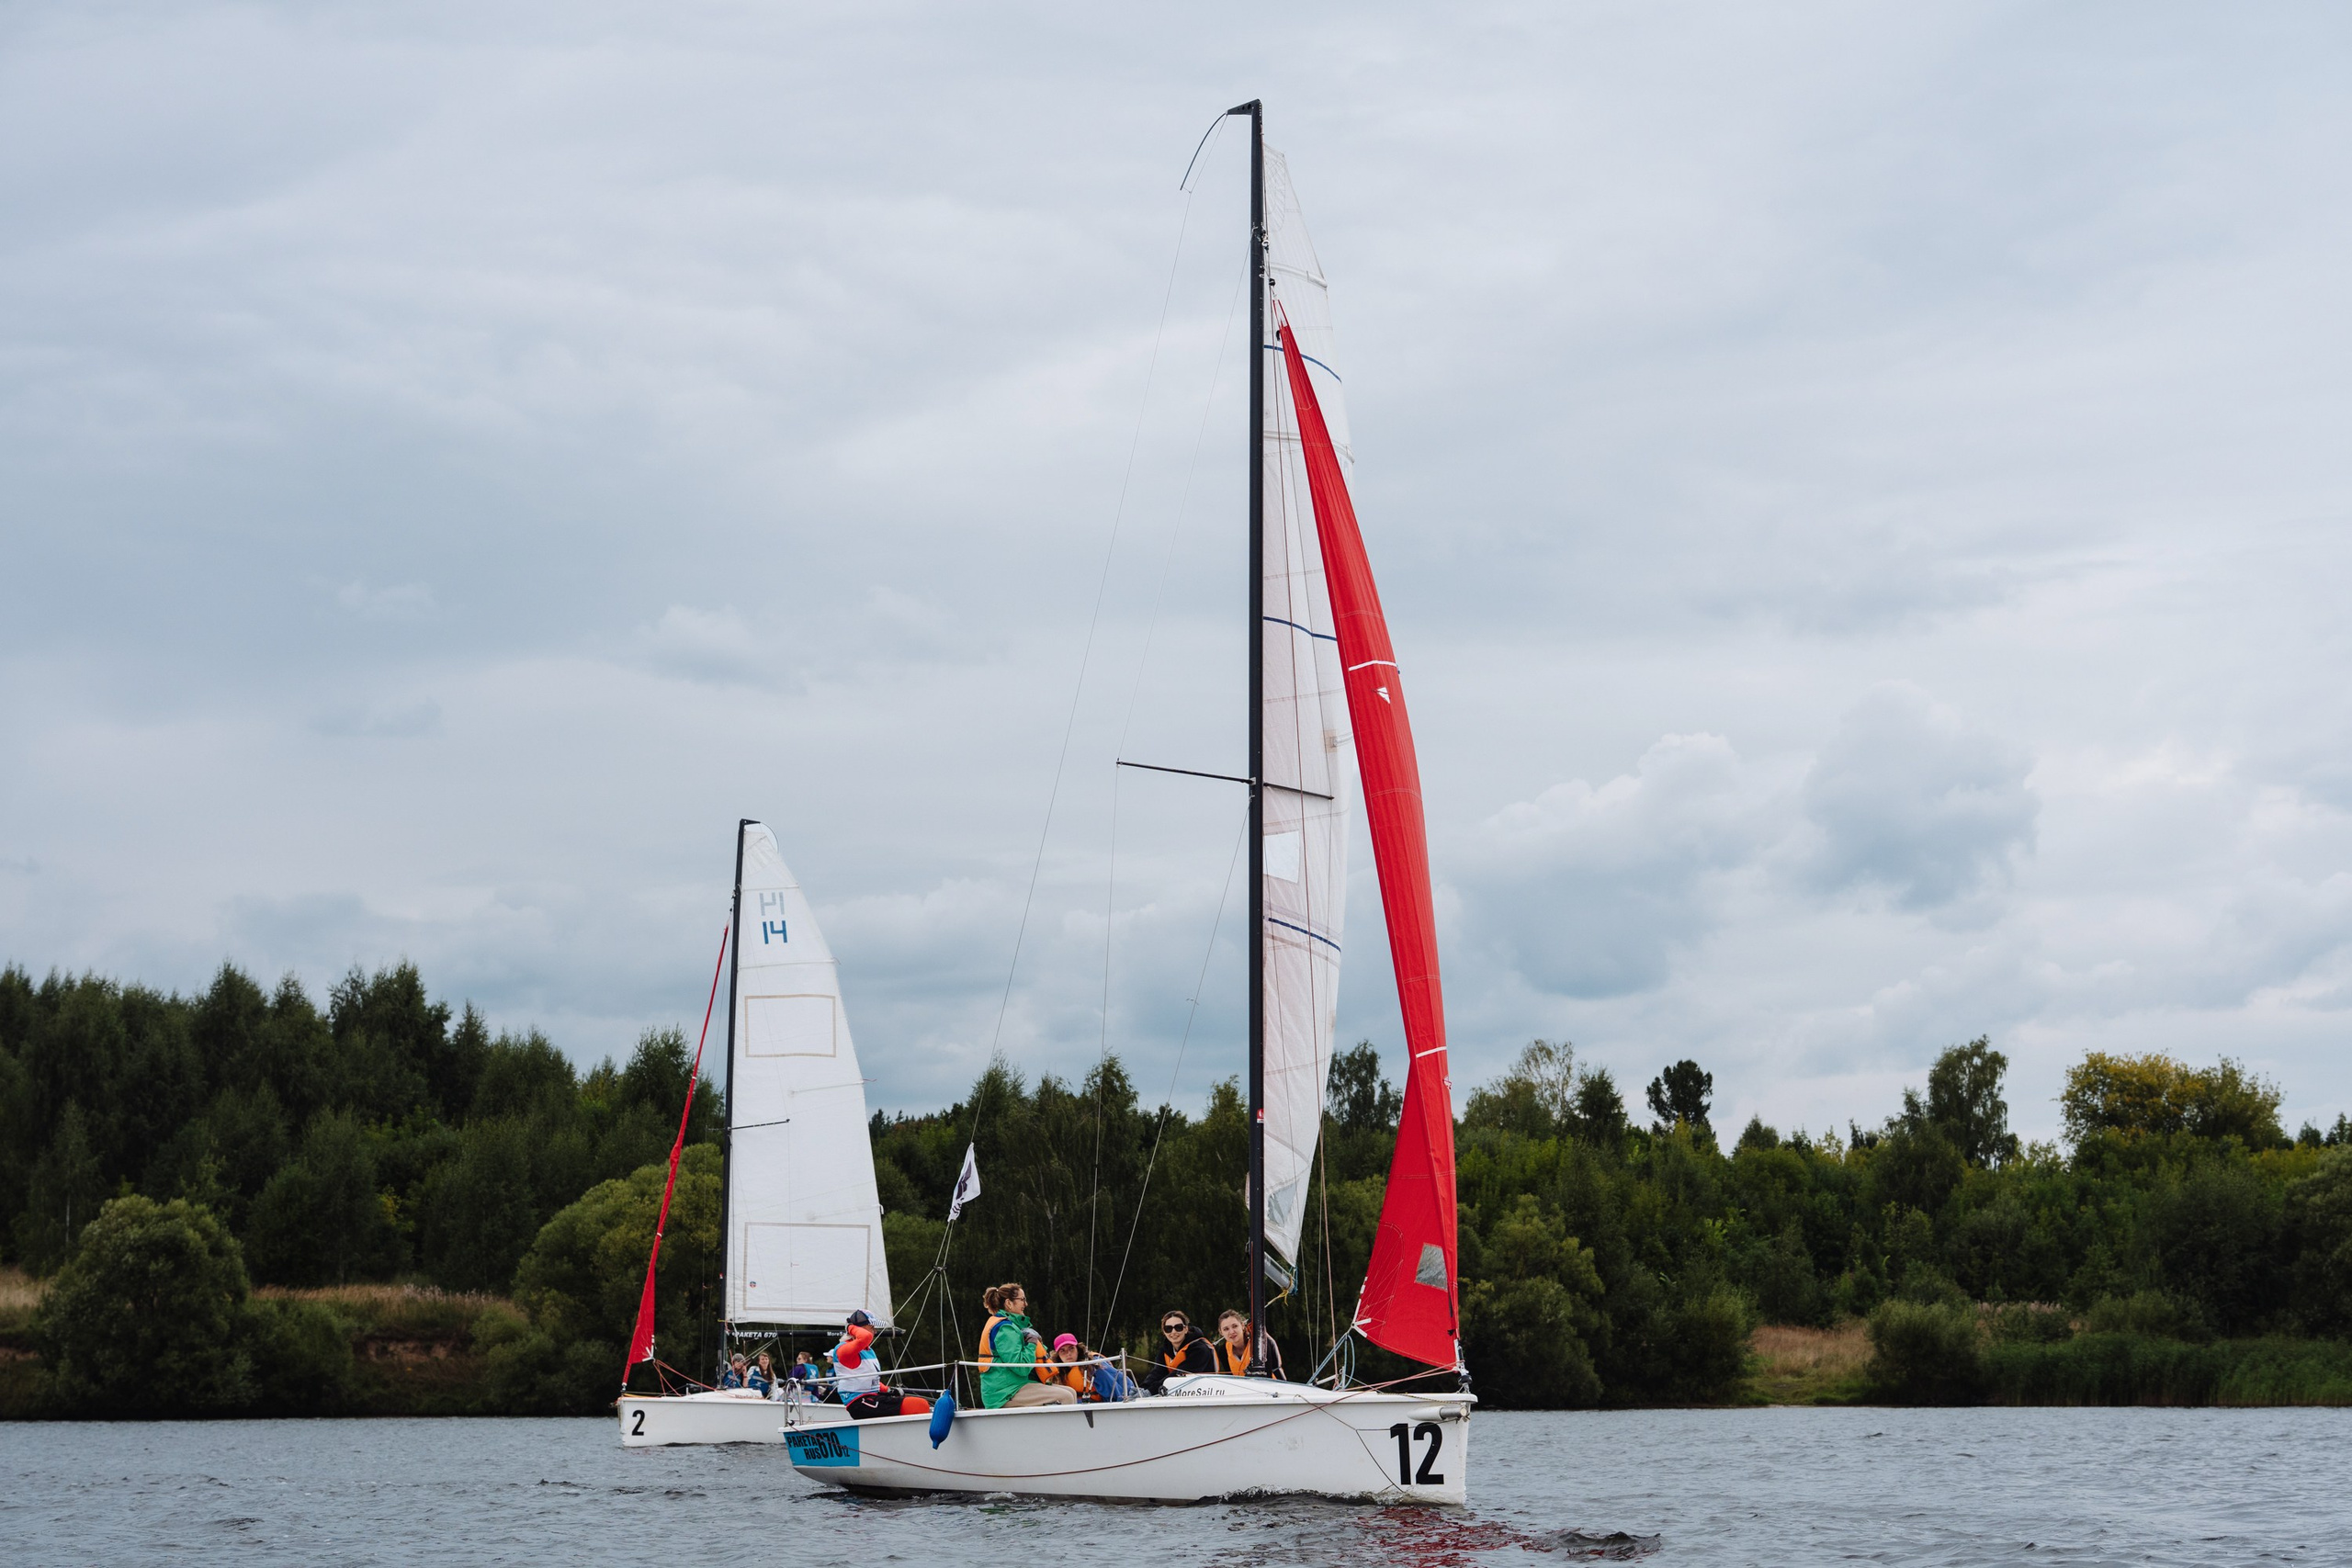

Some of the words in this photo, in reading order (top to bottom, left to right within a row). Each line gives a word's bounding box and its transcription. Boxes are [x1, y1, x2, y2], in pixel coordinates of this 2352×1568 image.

[763, 920, 787, 944] 14
[631, 1409, 646, 1436] 2
[804, 1448, 822, 1461] RUS
[816, 1431, 842, 1459] 670
[1390, 1422, 1444, 1485] 12
